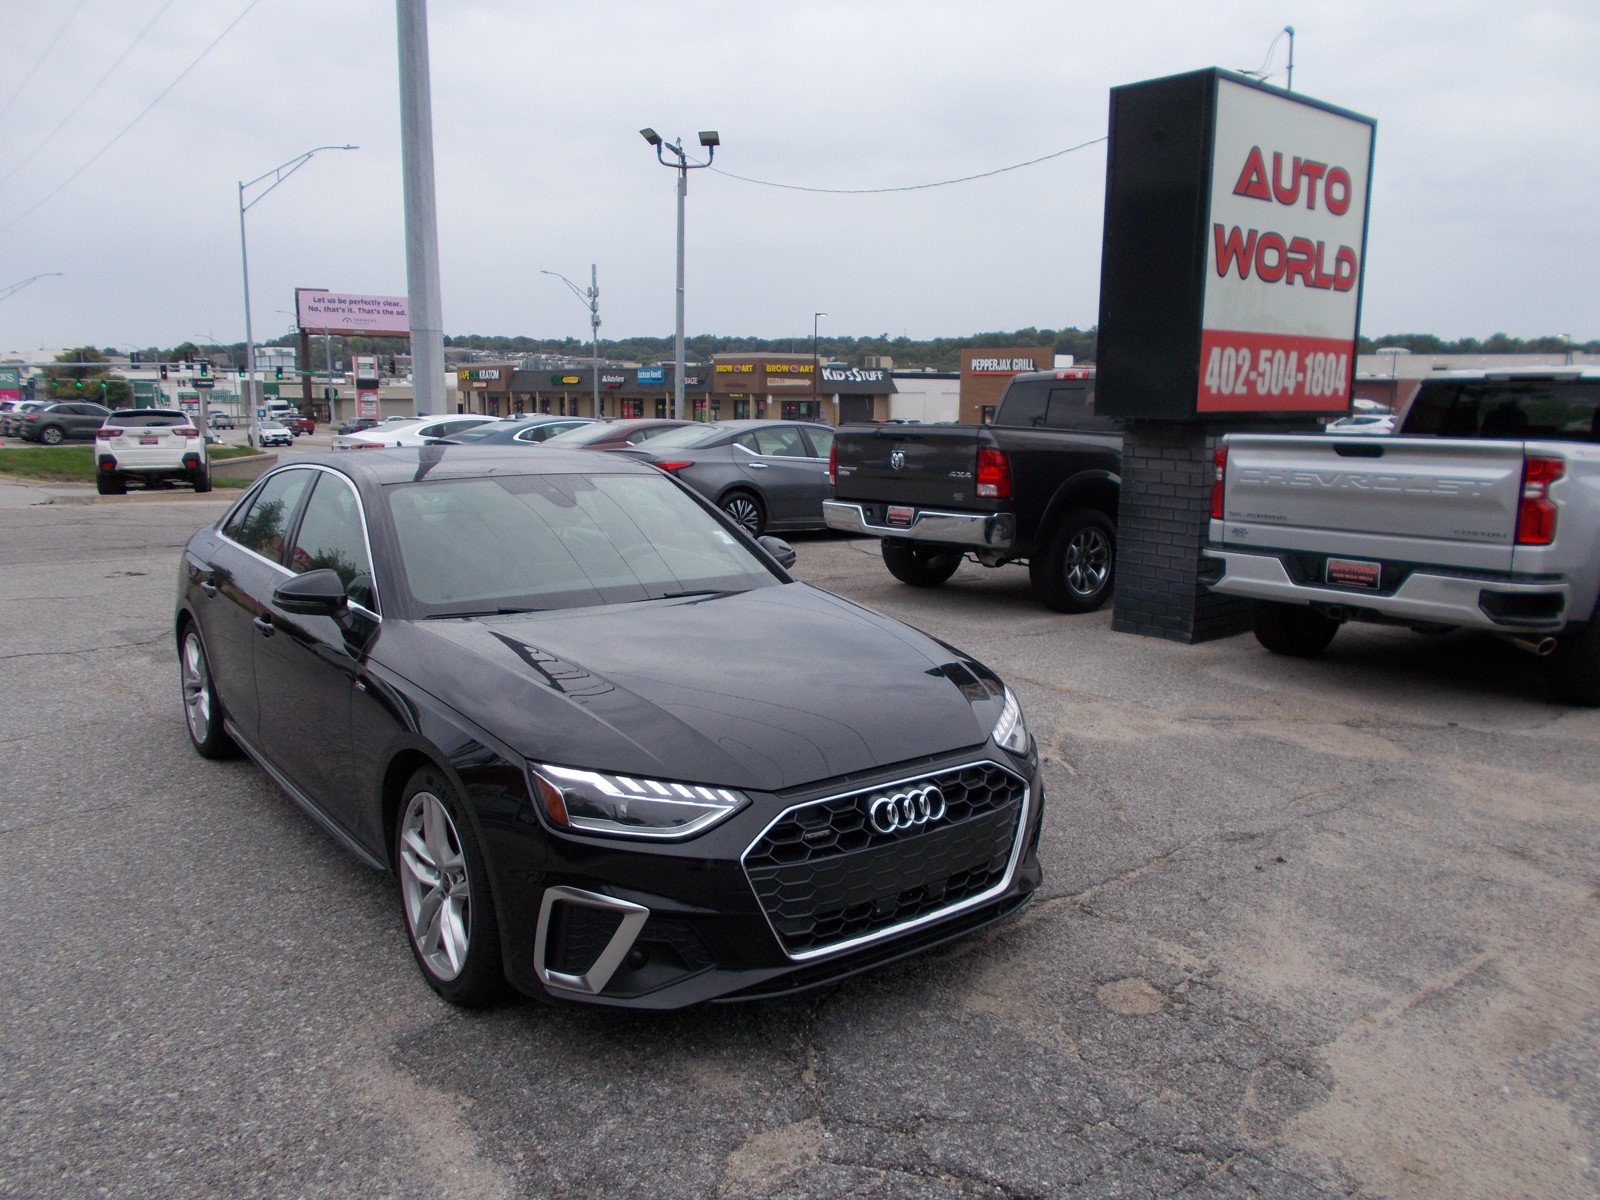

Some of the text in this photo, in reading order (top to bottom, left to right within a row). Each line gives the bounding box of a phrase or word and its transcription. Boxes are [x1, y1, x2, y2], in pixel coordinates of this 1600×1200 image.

[1232, 145, 1352, 216] AUTO
[1213, 222, 1358, 292] WORLD
[348, 298, 380, 307] perfectly
[308, 305, 321, 313] No,
[715, 364, 753, 372] BROW ART
[765, 364, 815, 373] BROW ART
[971, 358, 1035, 371] PEPPERJAX GRILL
[460, 369, 470, 380] VAPE
[479, 369, 500, 380] KRATOM
[852, 367, 884, 382] STUFF
[1204, 346, 1348, 396] 402-504-1804
[684, 377, 698, 385] SAGE
[1329, 563, 1350, 571] AUTO
